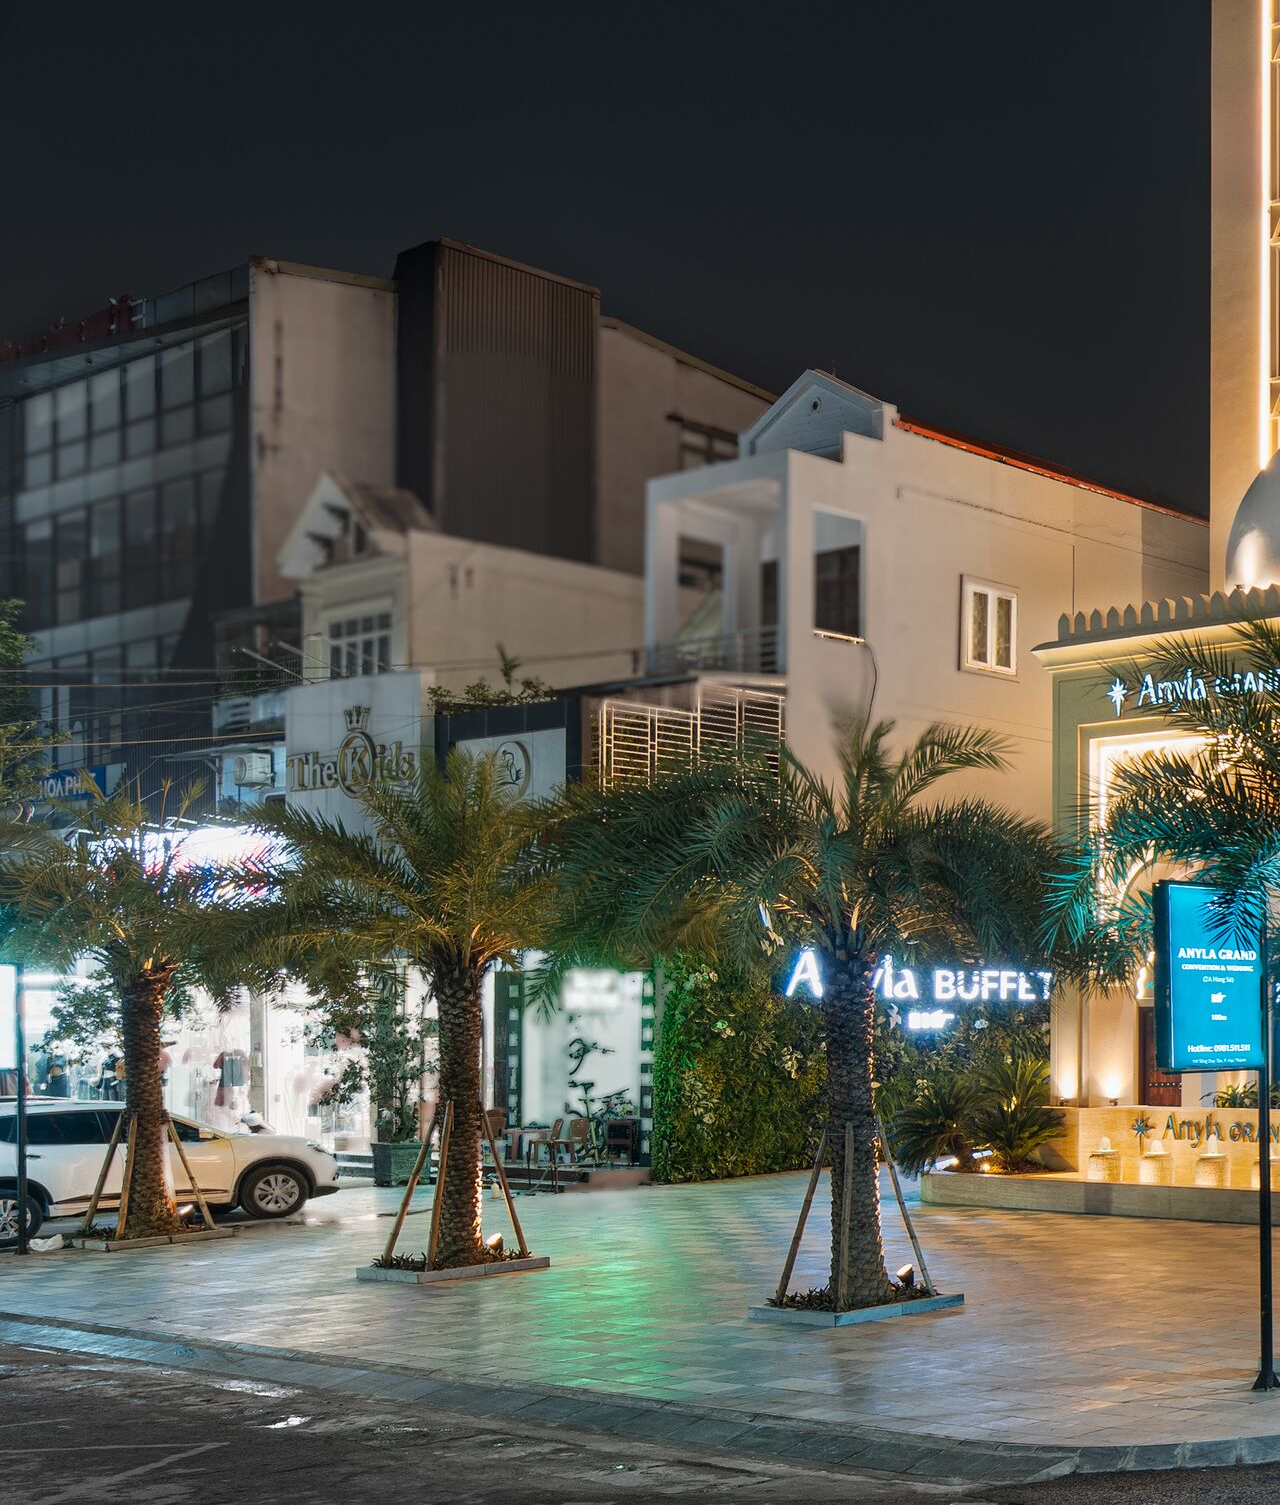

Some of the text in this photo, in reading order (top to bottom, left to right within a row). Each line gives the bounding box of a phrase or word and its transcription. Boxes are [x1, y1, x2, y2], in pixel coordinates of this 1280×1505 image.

[287, 751, 338, 792] The
[1177, 947, 1257, 961] ANYLA GRAND
[934, 967, 1053, 1000] BUFFET
